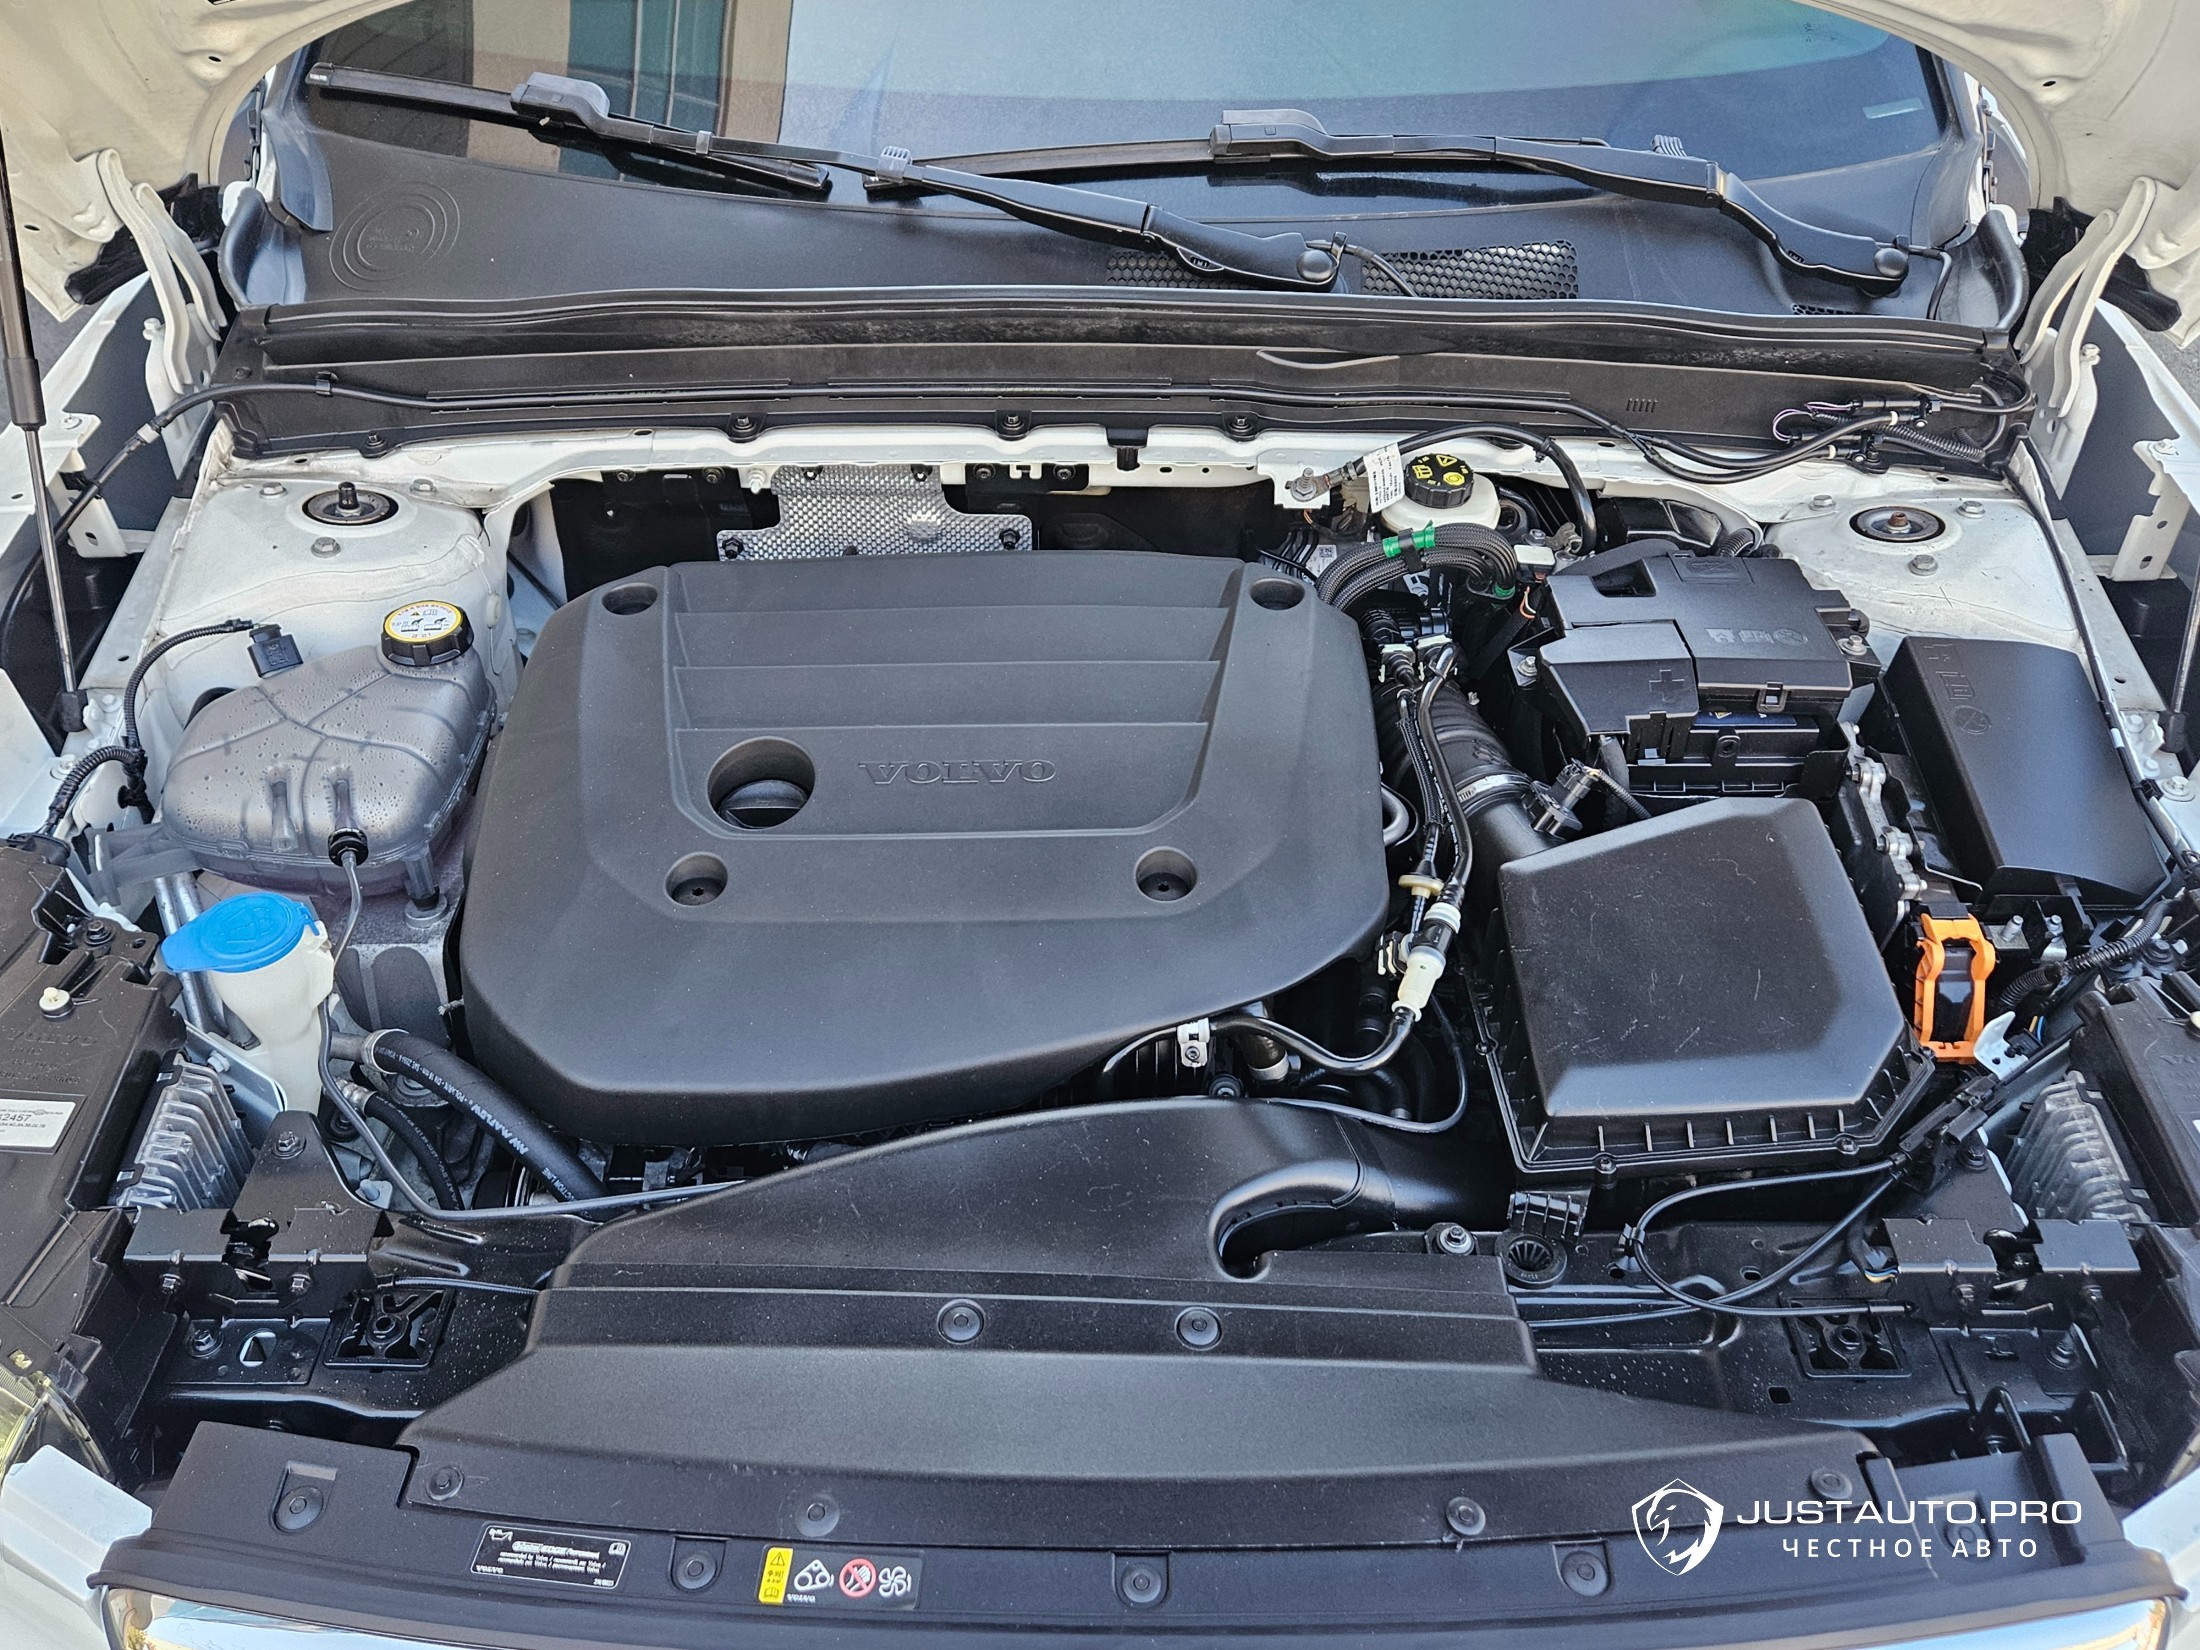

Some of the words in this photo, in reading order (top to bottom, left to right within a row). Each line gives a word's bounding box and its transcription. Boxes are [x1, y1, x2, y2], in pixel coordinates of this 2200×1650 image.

[858, 760, 1056, 785] VOLVO
[541, 1167, 557, 1182] LINE
[476, 1564, 503, 1574] VOLVO
[787, 1593, 816, 1603] VOLVO
